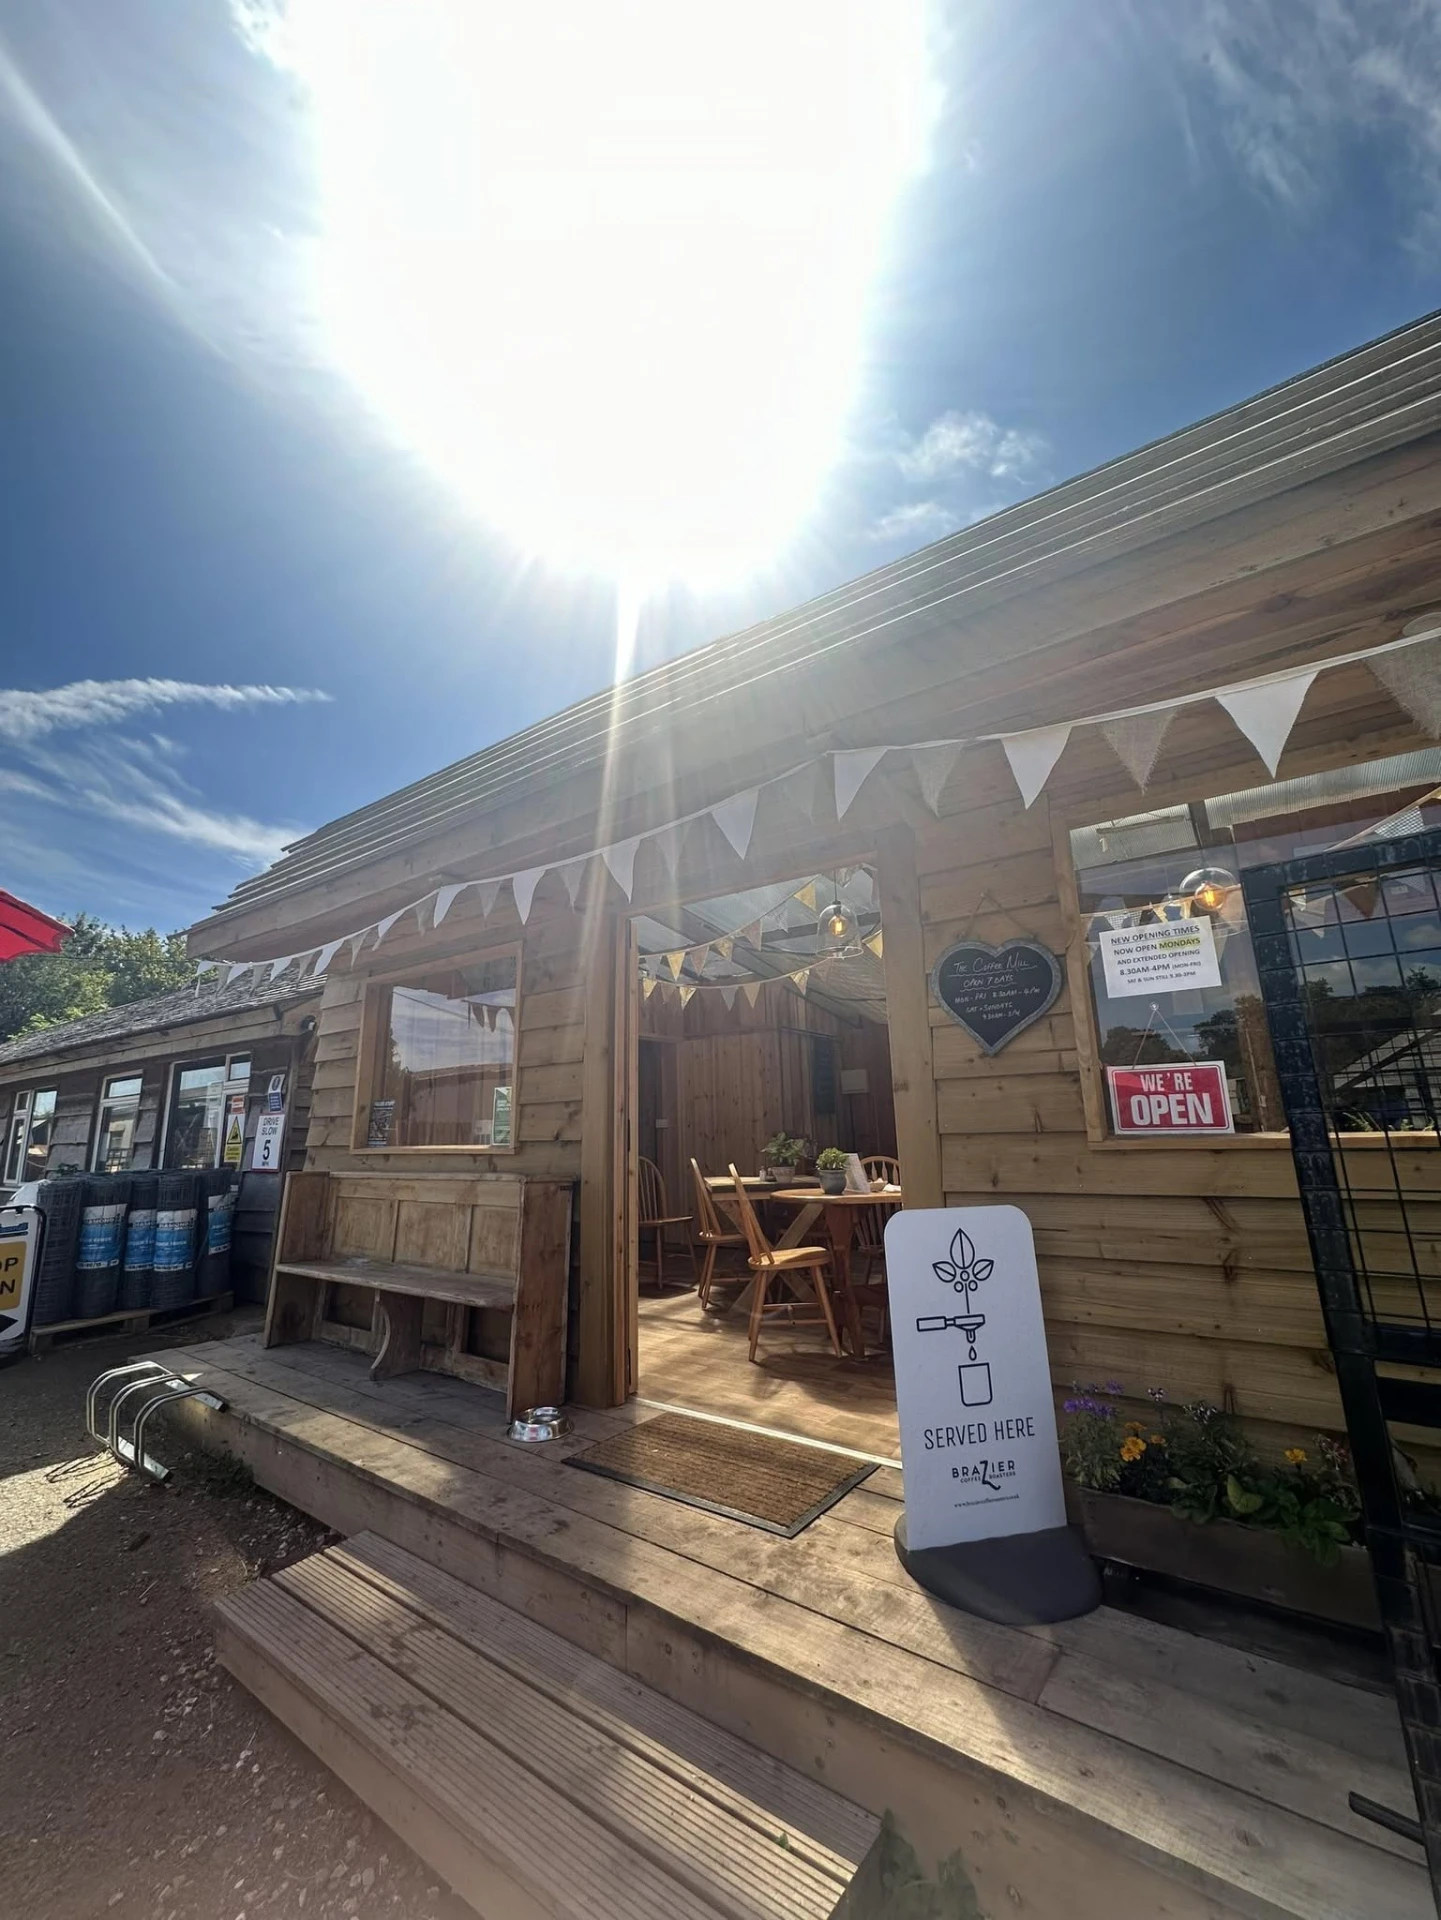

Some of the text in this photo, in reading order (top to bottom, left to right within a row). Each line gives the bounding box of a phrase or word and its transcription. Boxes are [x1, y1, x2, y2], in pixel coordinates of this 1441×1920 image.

[1111, 925, 1200, 945] NEW OPENING TIMES
[1114, 937, 1201, 955] NOW OPEN MONDAYS
[1133, 954, 1167, 963] EXTENDED
[1168, 948, 1200, 958] OPENING
[1119, 963, 1171, 976] 8.30AM-4PM
[994, 975, 1014, 985] DAYS
[1140, 1072, 1193, 1092] WE'RE
[1130, 1092, 1214, 1126] OPEN
[261, 1126, 278, 1136] SLOW
[263, 1117, 280, 1126] DRIVE
[262, 1139, 271, 1160] 5
[924, 1416, 1036, 1450] SERVED HERE
[952, 1459, 1016, 1491] BRAZIER
